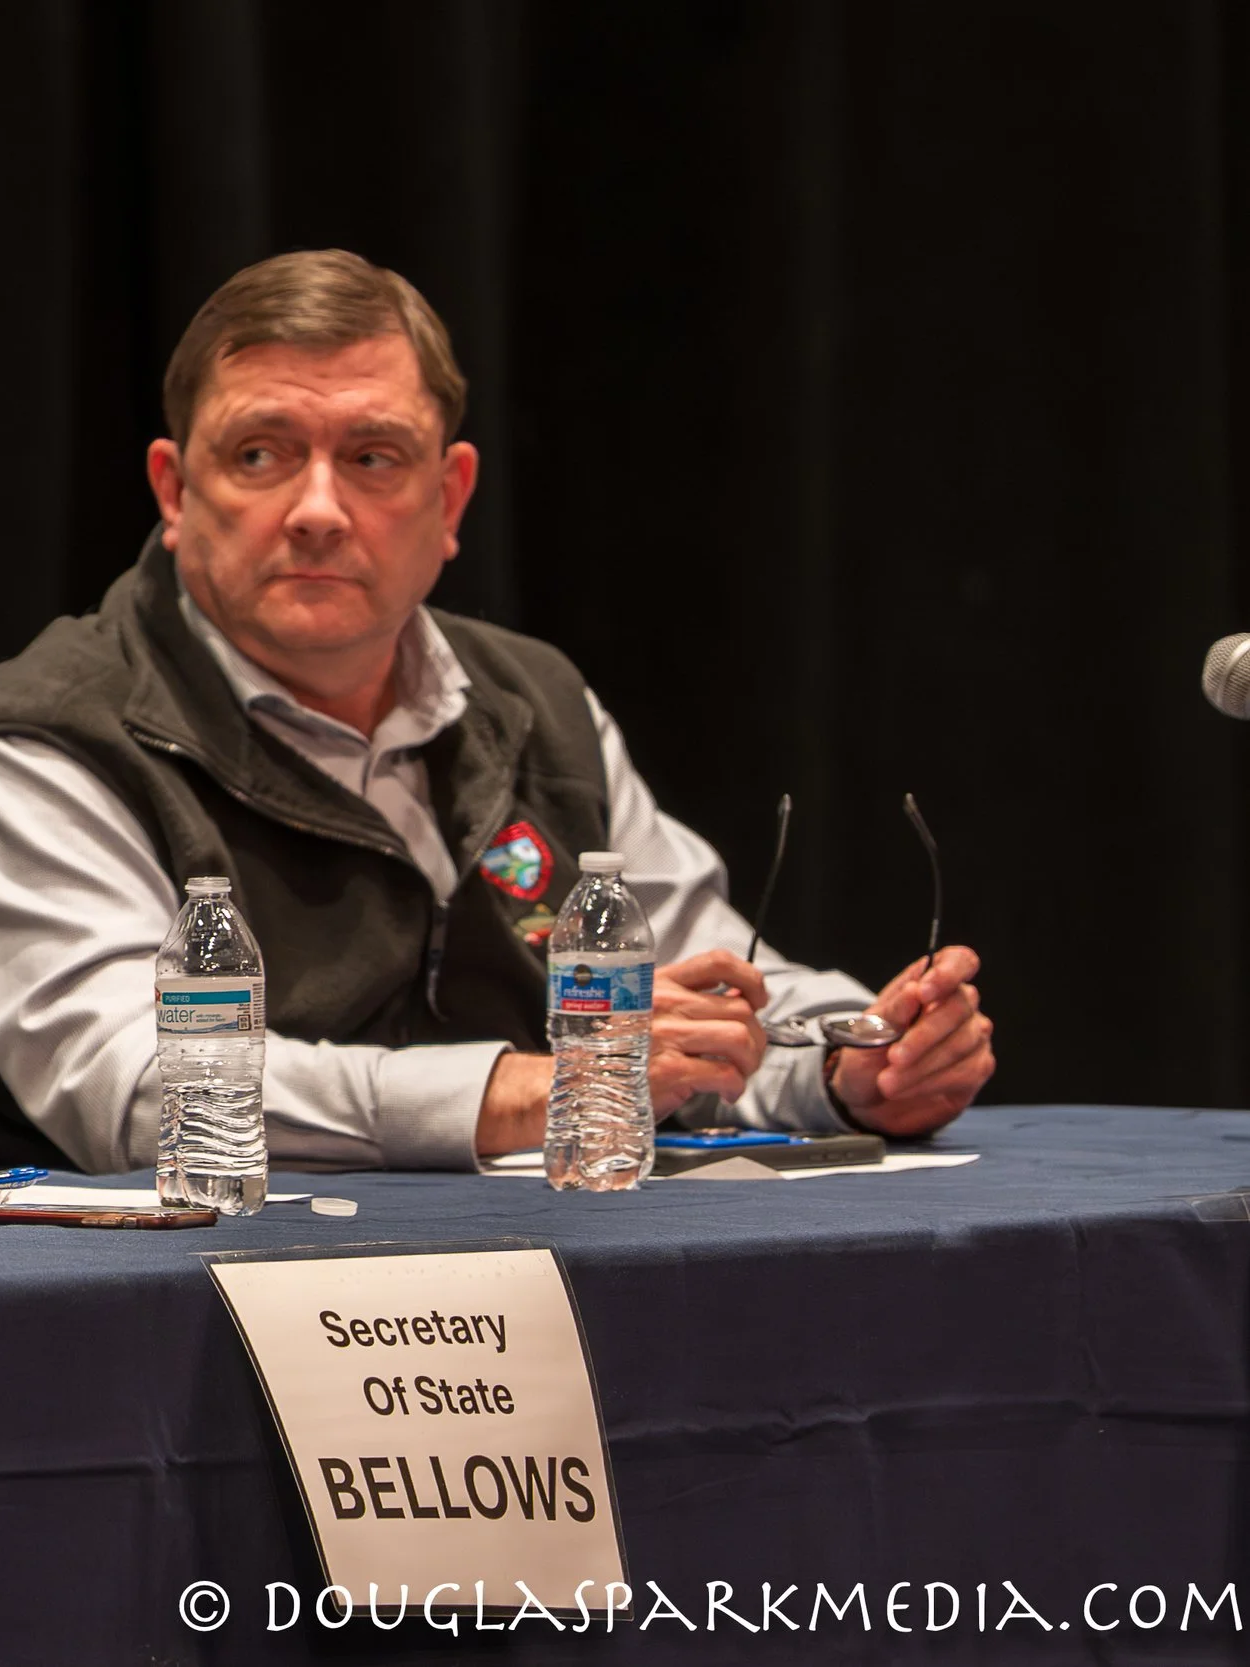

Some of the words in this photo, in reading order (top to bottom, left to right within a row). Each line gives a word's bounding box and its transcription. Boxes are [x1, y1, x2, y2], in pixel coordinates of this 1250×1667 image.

[157, 1007, 196, 1023] water
[319, 1310, 507, 1354] Secretary
[363, 1376, 410, 1416] Of
[414, 1375, 515, 1415] State
[317, 1455, 596, 1523] BELLOWS
